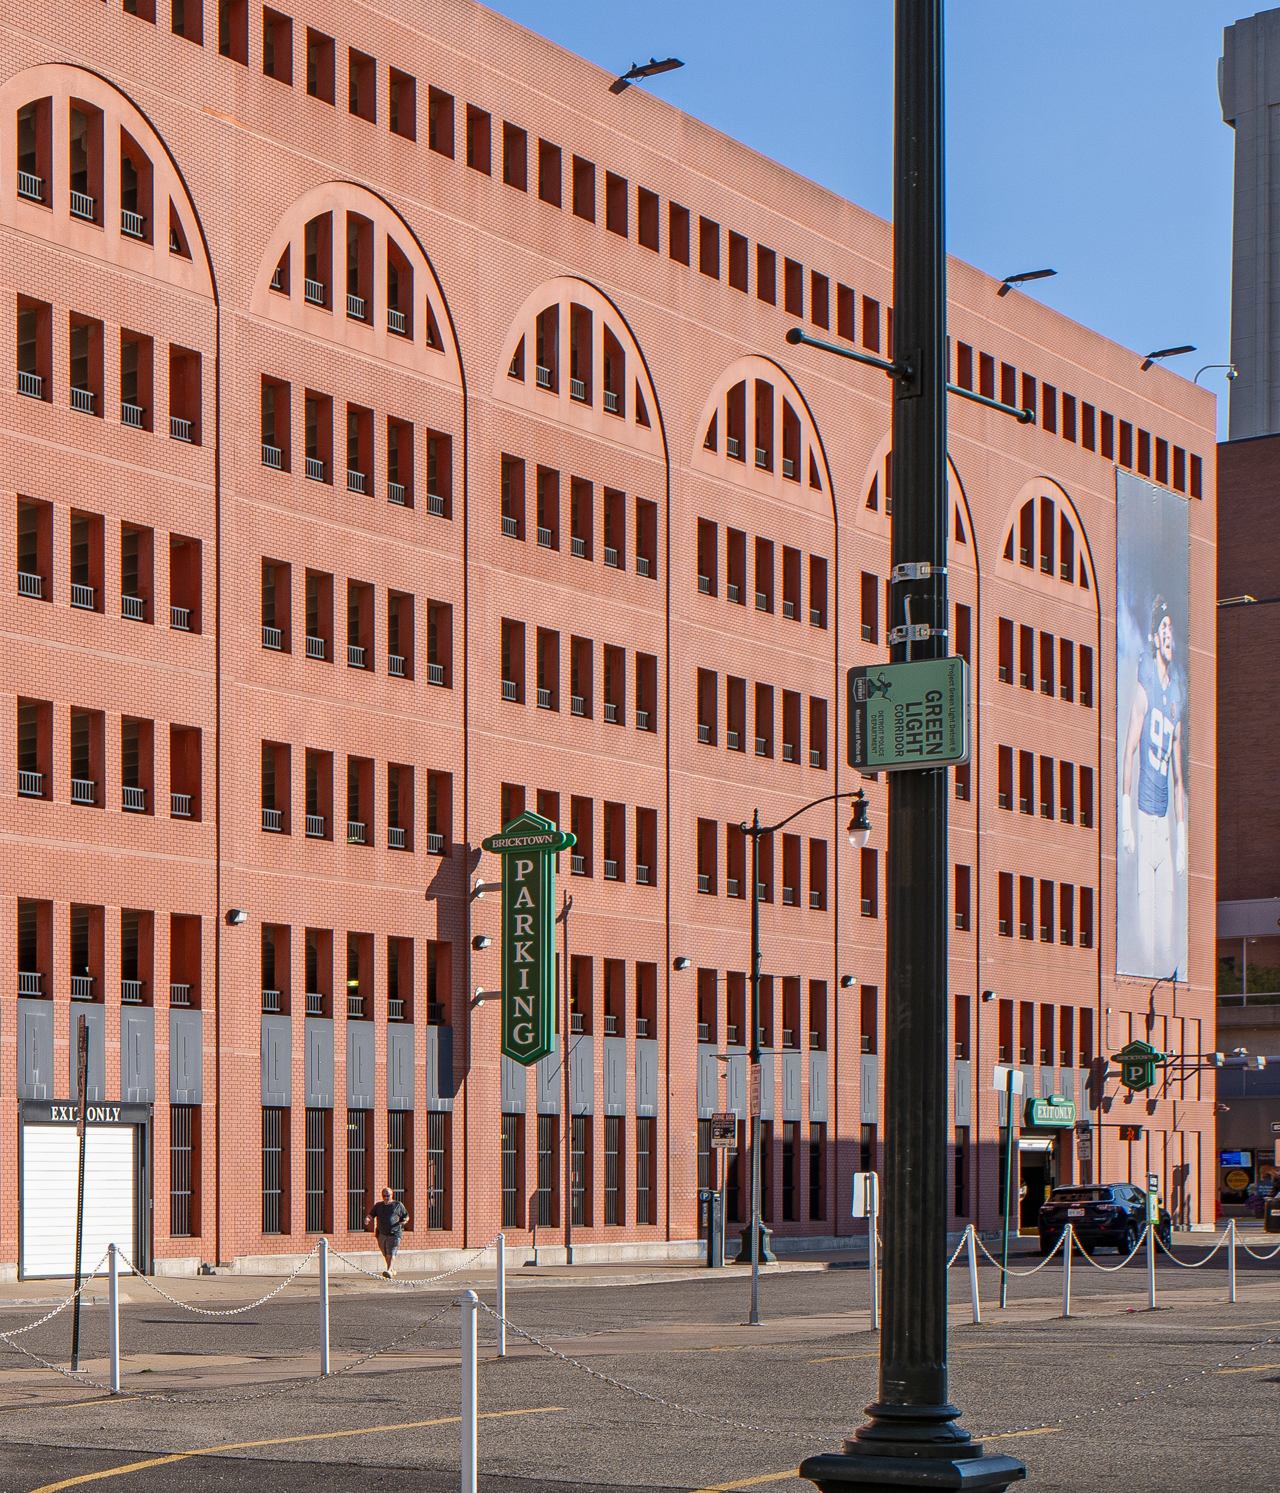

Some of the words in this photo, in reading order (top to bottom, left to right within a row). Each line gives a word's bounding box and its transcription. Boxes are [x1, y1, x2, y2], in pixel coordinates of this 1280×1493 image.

[947, 663, 956, 686] Project
[877, 710, 885, 735] DETROIT
[924, 689, 943, 756] GREEN
[947, 707, 956, 723] Light
[870, 714, 878, 755] DEPARTMENT
[894, 703, 905, 758] CORRIDOR
[905, 701, 924, 756] LIGHT
[1148, 707, 1175, 777] 97
[491, 834, 554, 849] BRICKTOWN
[512, 859, 536, 1045] PARKING
[1129, 1066, 1144, 1081] P
[86, 1106, 121, 1122] ONLY
[1037, 1105, 1054, 1119] EXIT
[1054, 1106, 1073, 1120] ONLY
